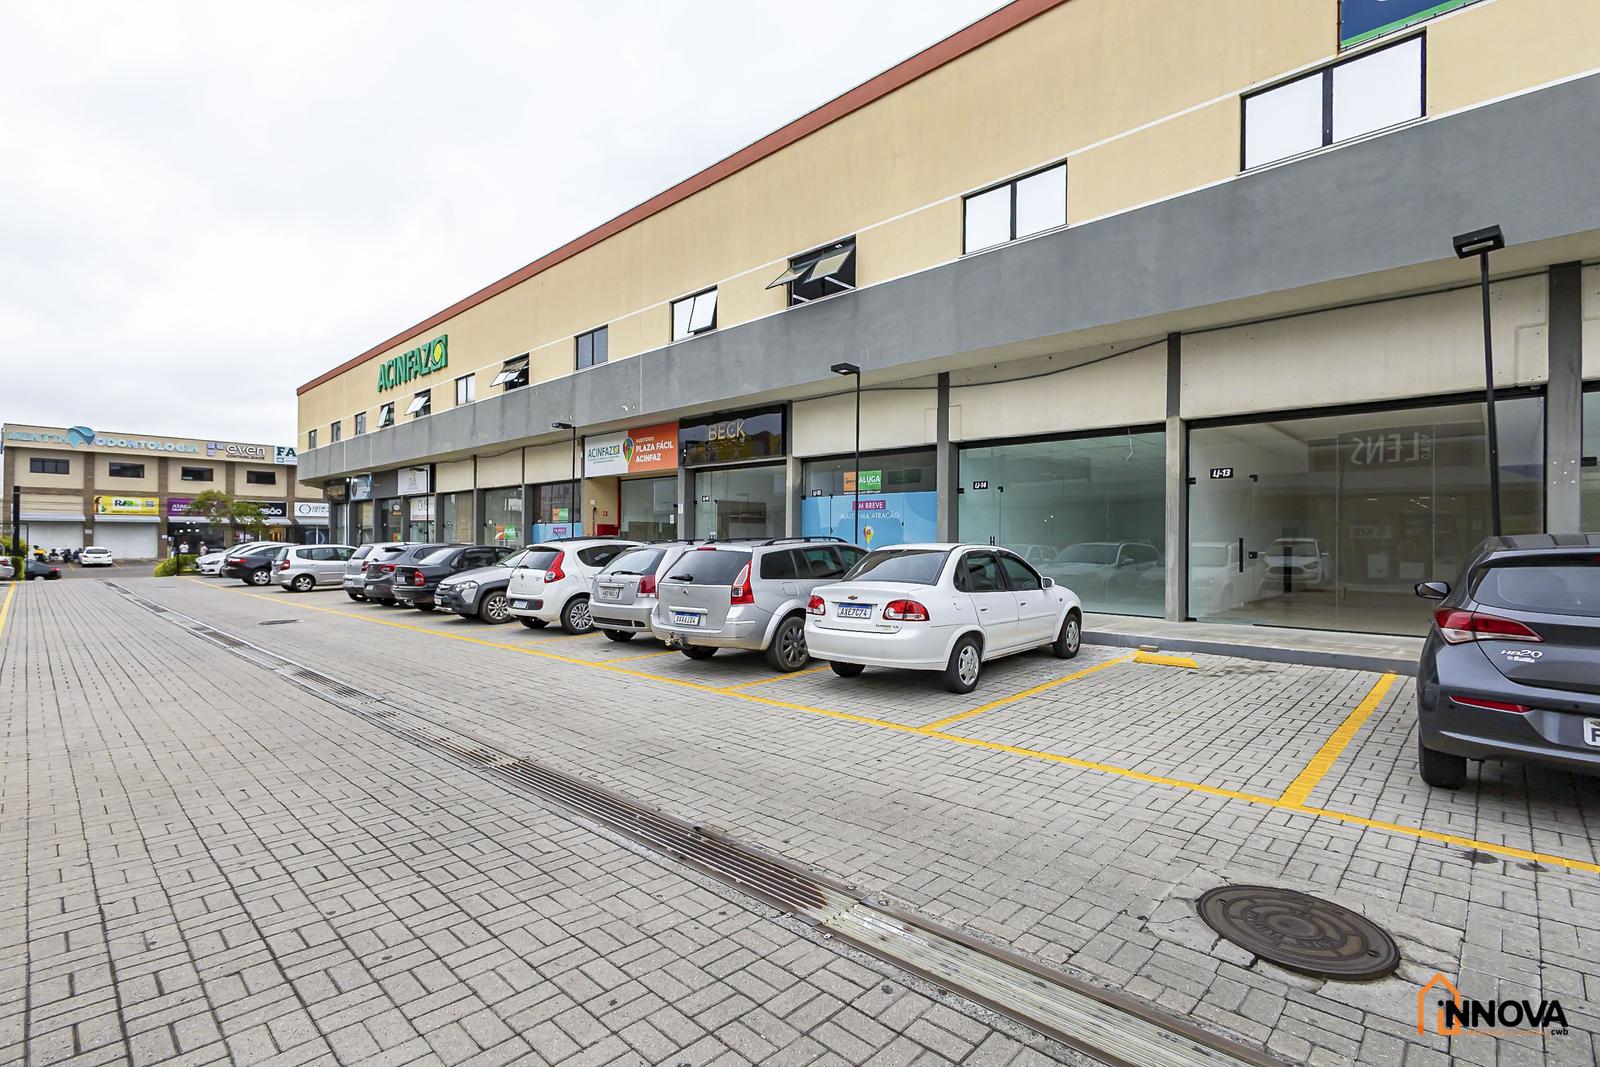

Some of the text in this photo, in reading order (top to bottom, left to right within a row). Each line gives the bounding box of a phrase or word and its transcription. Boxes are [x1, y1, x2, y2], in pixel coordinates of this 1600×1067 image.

[708, 419, 746, 441] BECK
[94, 439, 199, 454] ODONTOLOGIA
[226, 444, 266, 456] even
[588, 445, 613, 458] ACINFAZ
[636, 440, 673, 453] PLAZA FÁCIL
[636, 453, 661, 463] ACINFAZ
[1212, 469, 1231, 478] LJ-13
[865, 501, 883, 509] BREVE
[840, 608, 867, 617] AXE7C74
[1500, 650, 1543, 659] HB20
